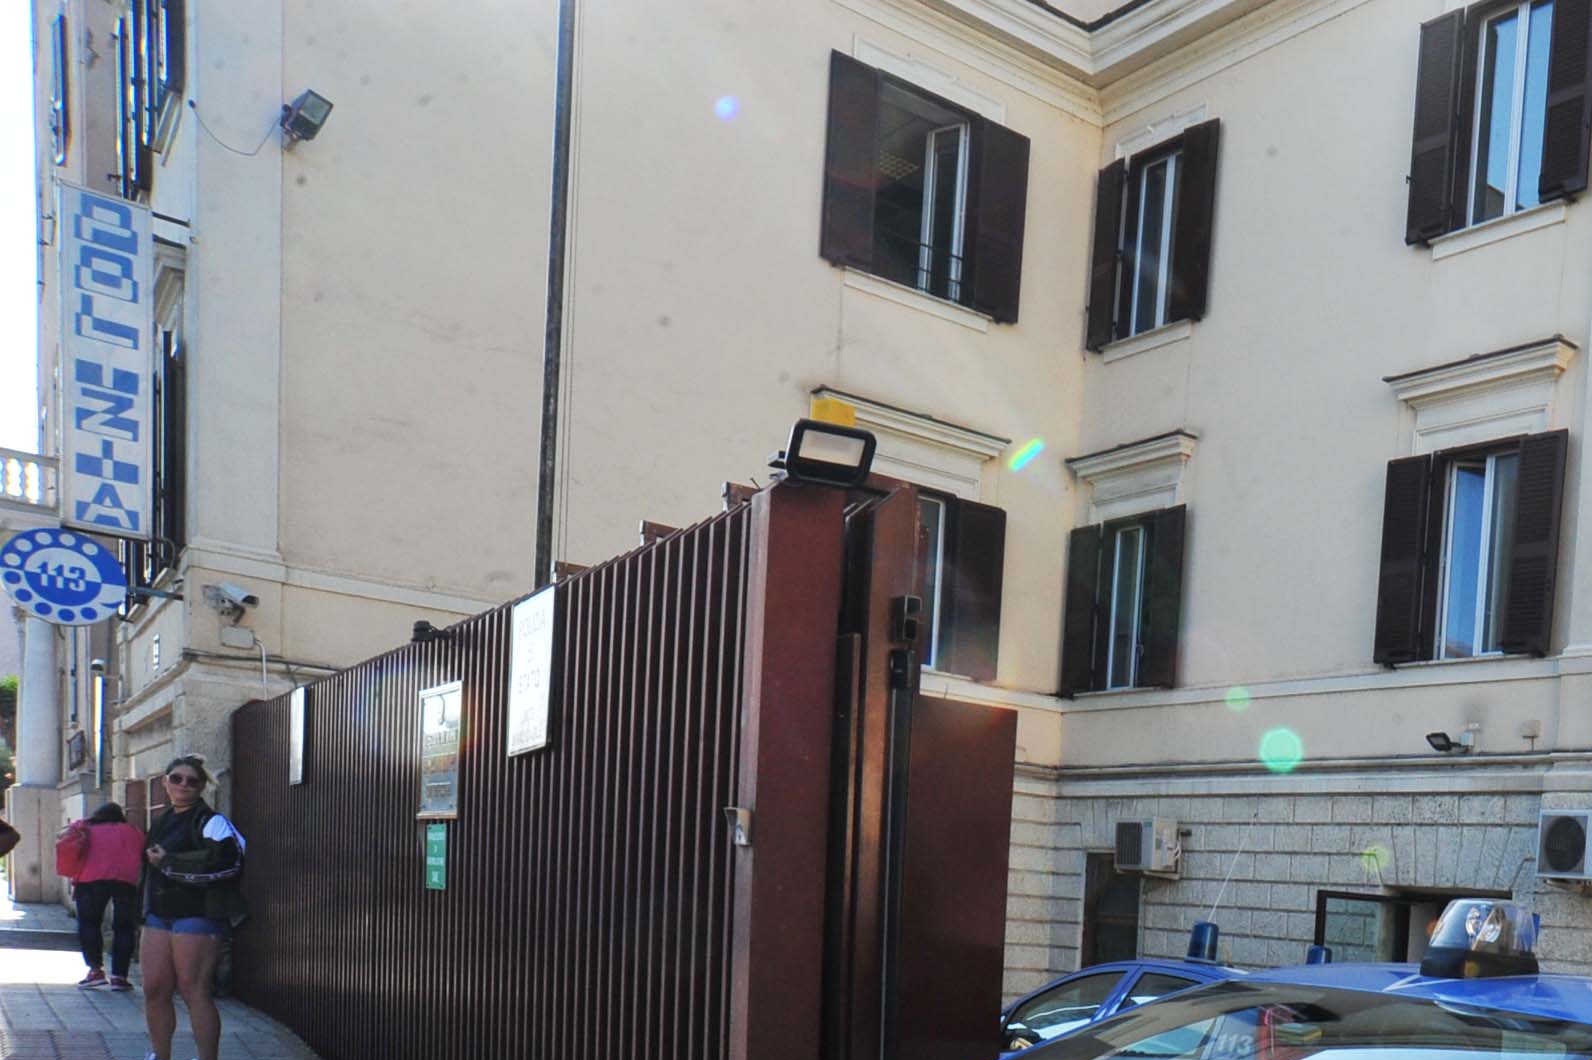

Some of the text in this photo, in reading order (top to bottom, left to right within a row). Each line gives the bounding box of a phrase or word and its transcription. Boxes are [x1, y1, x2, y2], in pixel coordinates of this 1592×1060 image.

[74, 193, 139, 531] POLIZIA
[37, 561, 86, 592] 113
[1217, 1033, 1253, 1056] 113
